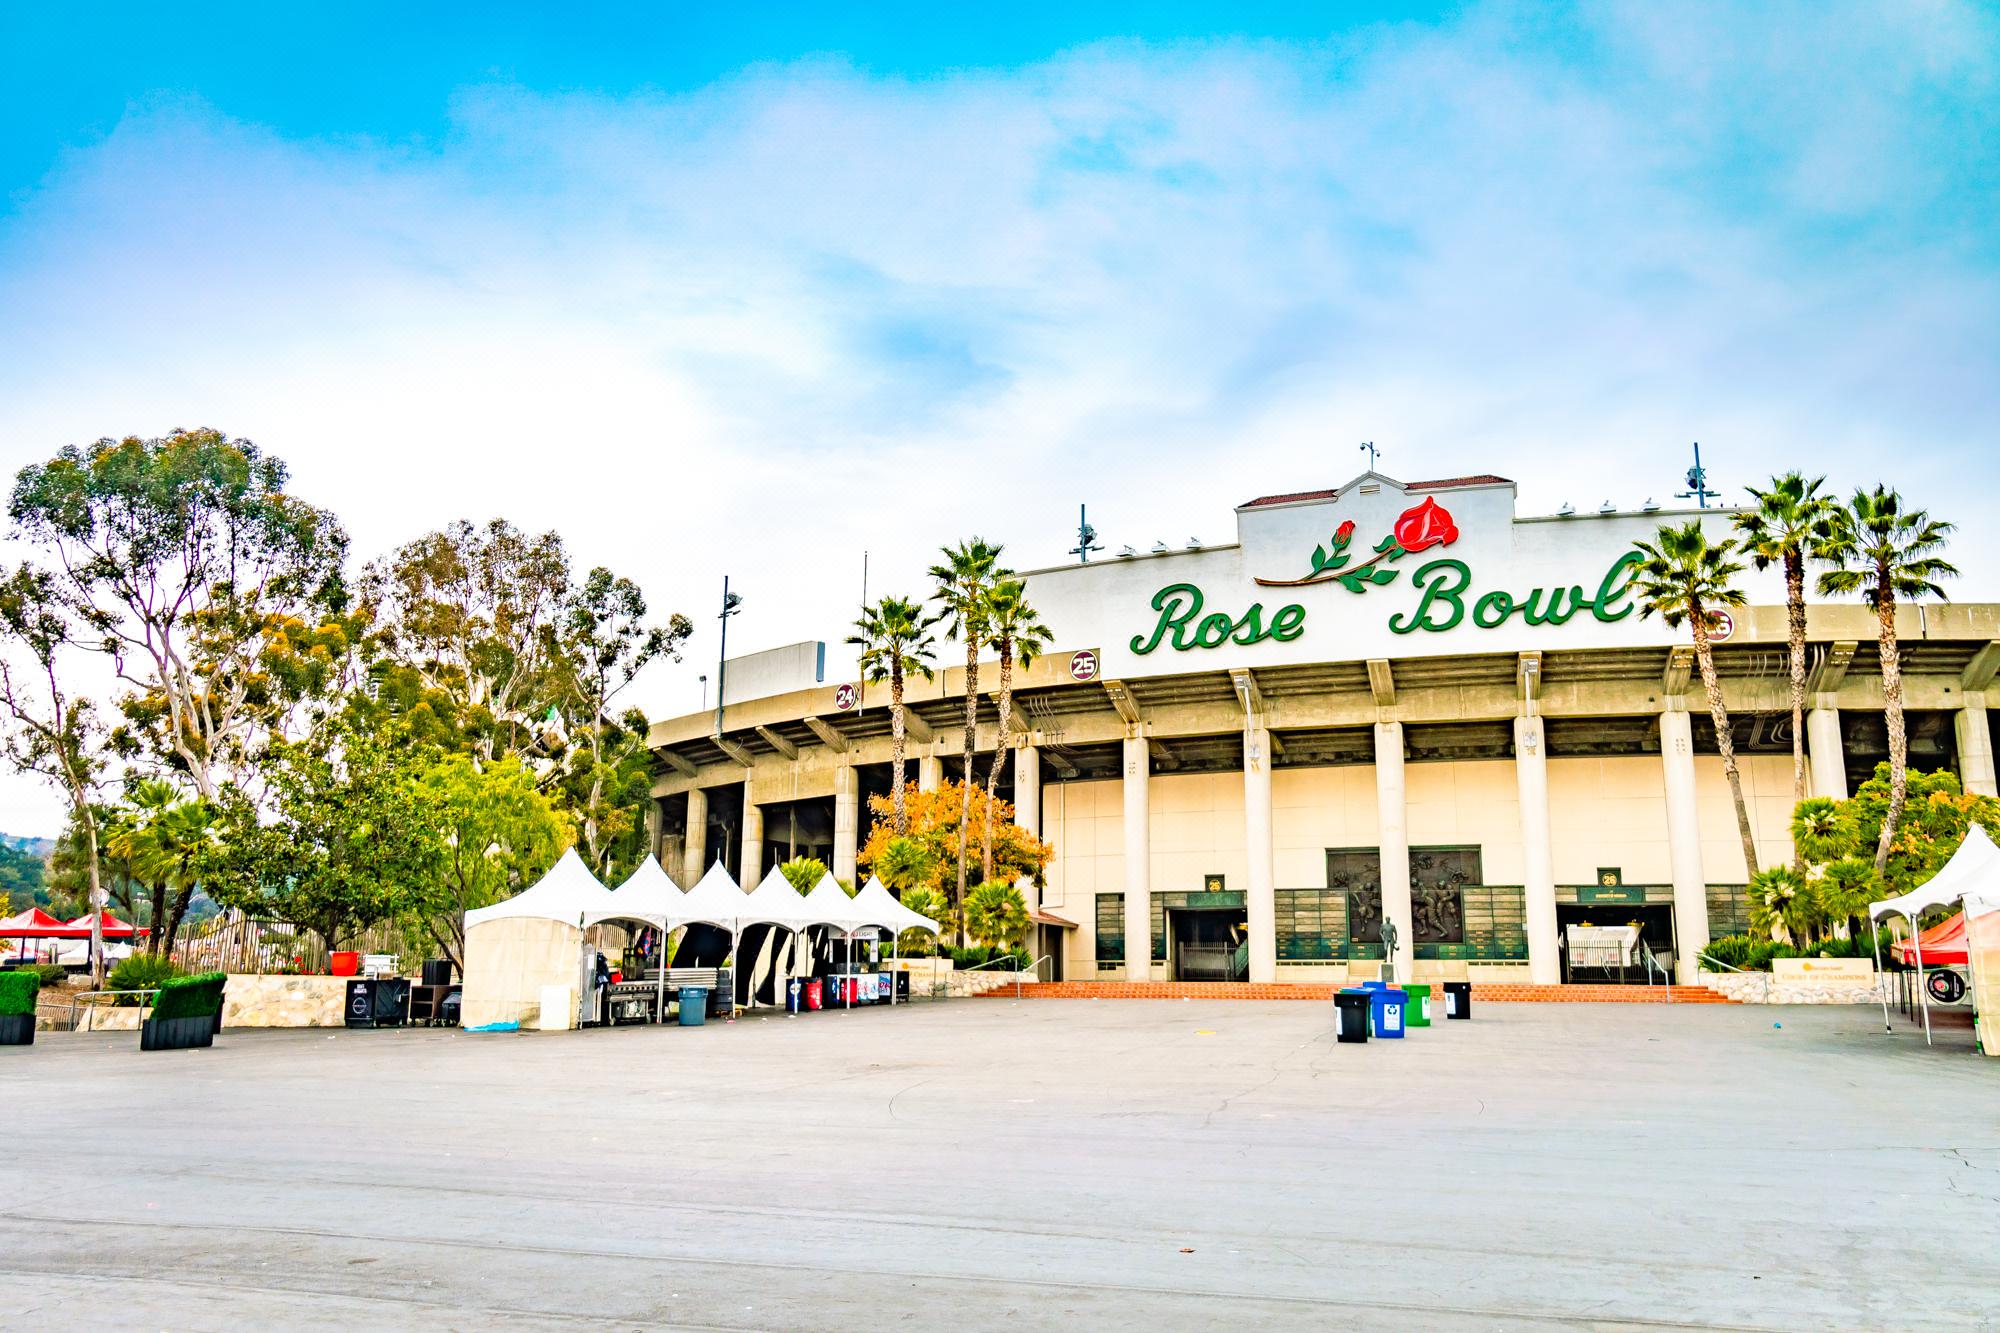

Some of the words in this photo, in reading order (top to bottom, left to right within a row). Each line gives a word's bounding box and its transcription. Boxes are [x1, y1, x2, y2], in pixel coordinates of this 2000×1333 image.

[1129, 582, 1306, 656] Rose
[1387, 550, 1646, 635] Bowl
[1072, 656, 1095, 675] 25
[837, 688, 854, 705] 24
